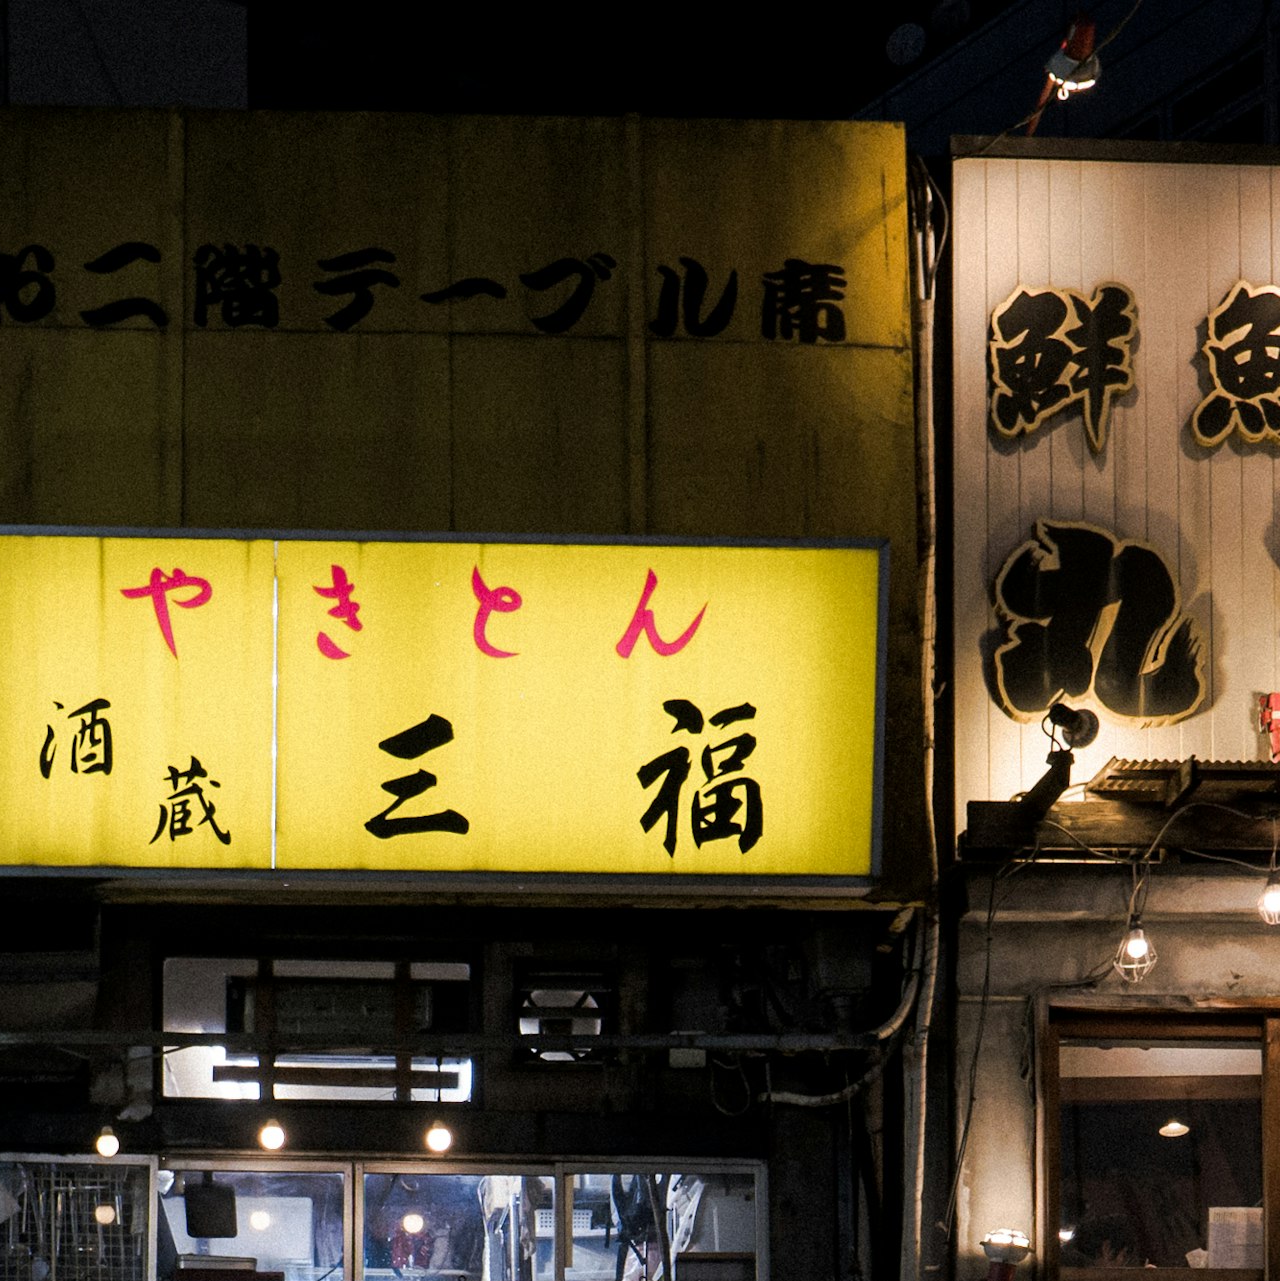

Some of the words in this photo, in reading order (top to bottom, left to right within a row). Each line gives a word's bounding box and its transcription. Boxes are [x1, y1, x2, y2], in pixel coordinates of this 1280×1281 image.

[120, 564, 709, 662] やきとん
[38, 697, 232, 847] 酒蔵
[363, 699, 765, 860] 三福
